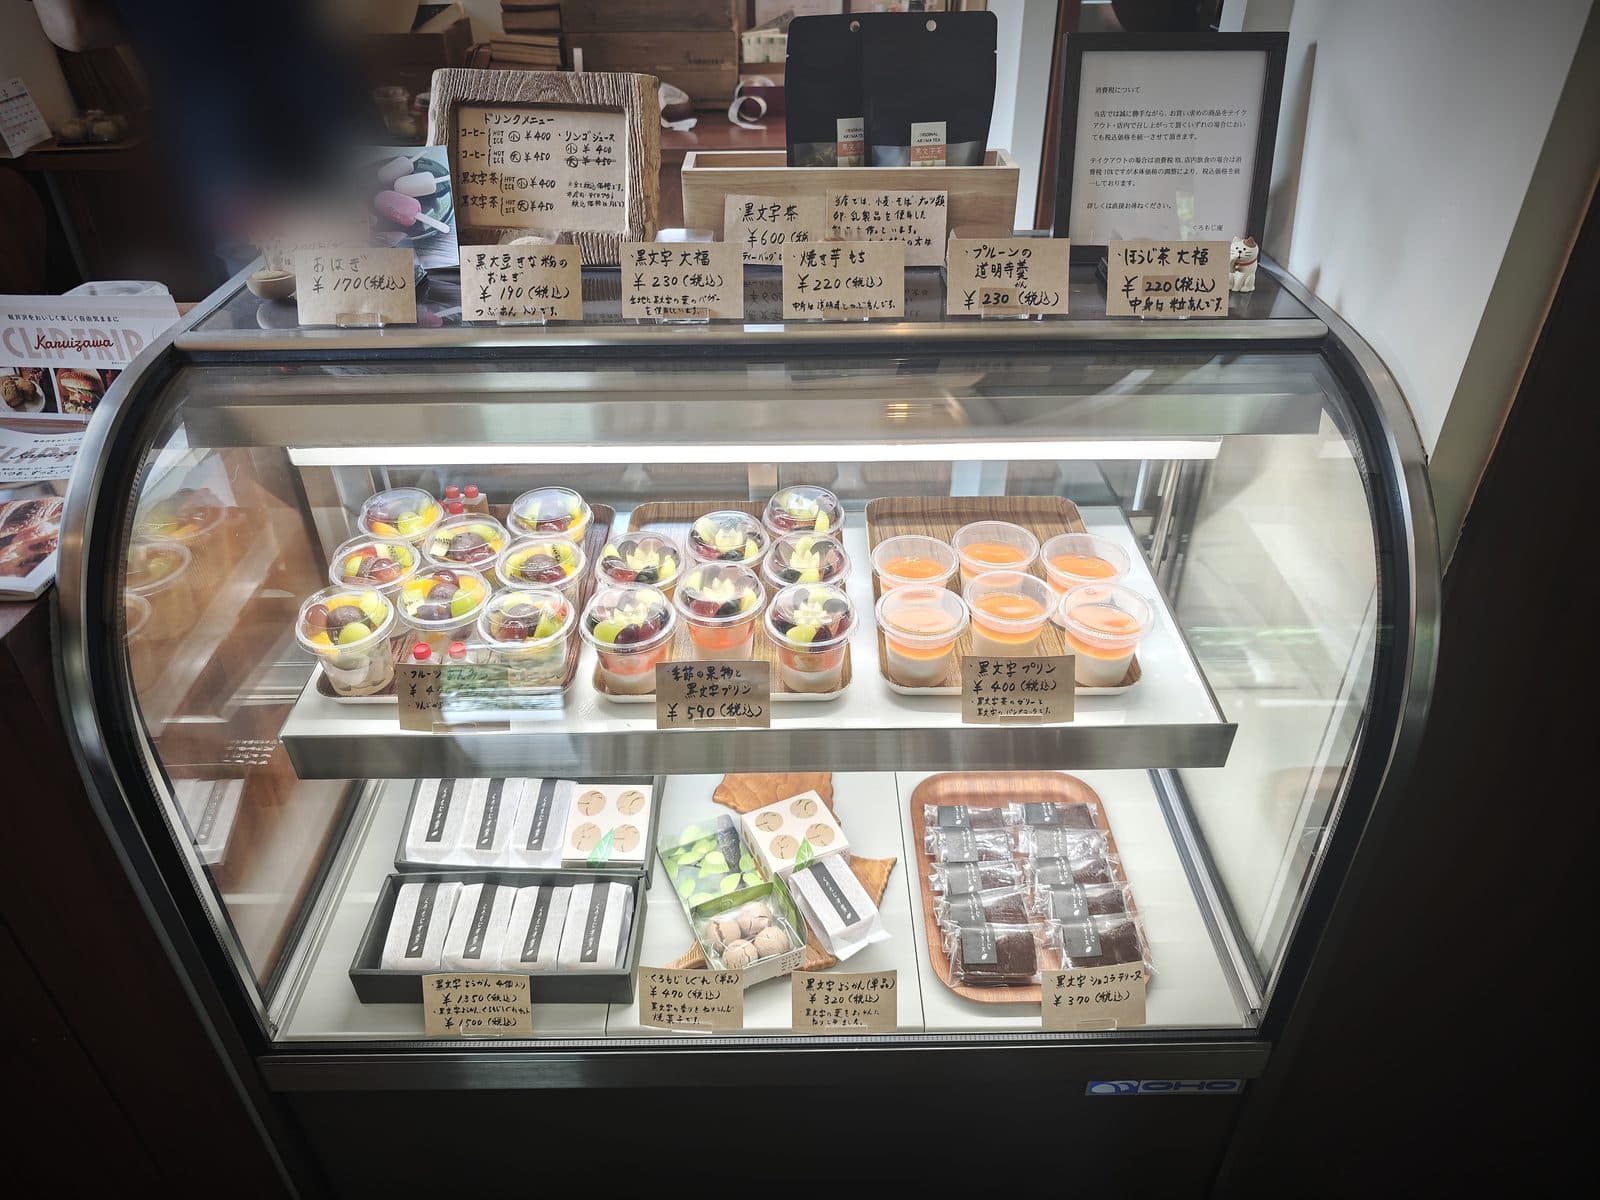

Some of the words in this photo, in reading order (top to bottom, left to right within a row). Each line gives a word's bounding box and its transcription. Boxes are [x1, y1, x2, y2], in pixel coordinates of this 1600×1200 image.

[483, 112, 555, 125] ドリンクメニュー
[971, 247, 1032, 260] プルーンの
[312, 255, 368, 273] おはぎ
[488, 272, 524, 284] おはぎ
[34, 335, 114, 352] Karuizawa
[671, 665, 742, 682] 季節の果物と
